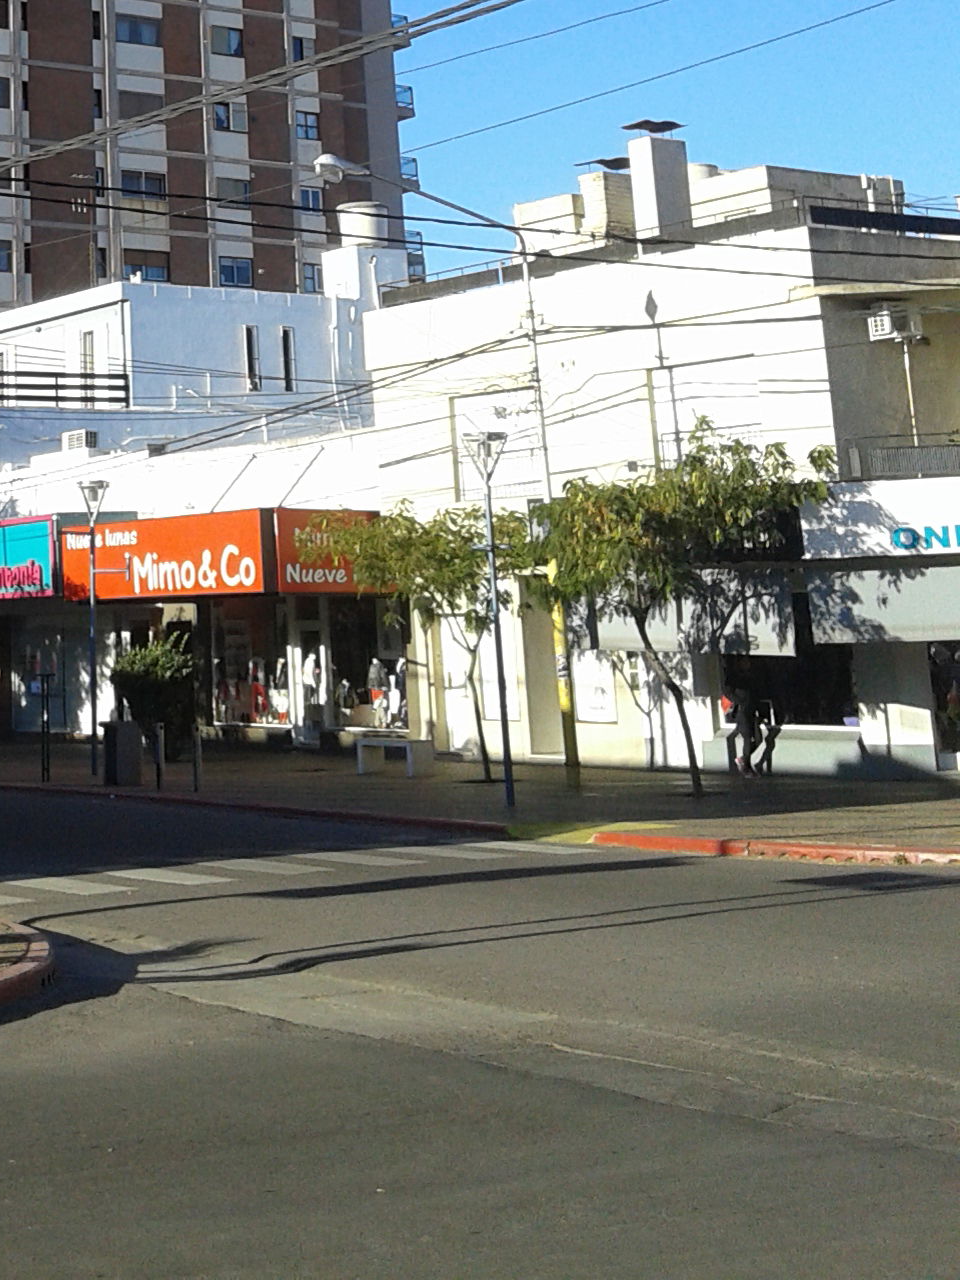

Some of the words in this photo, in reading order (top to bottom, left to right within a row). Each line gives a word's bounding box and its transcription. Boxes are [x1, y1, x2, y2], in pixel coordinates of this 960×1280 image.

[66, 532, 103, 551] Nuee
[105, 528, 138, 547] lunas
[285, 563, 348, 584] Nueve
